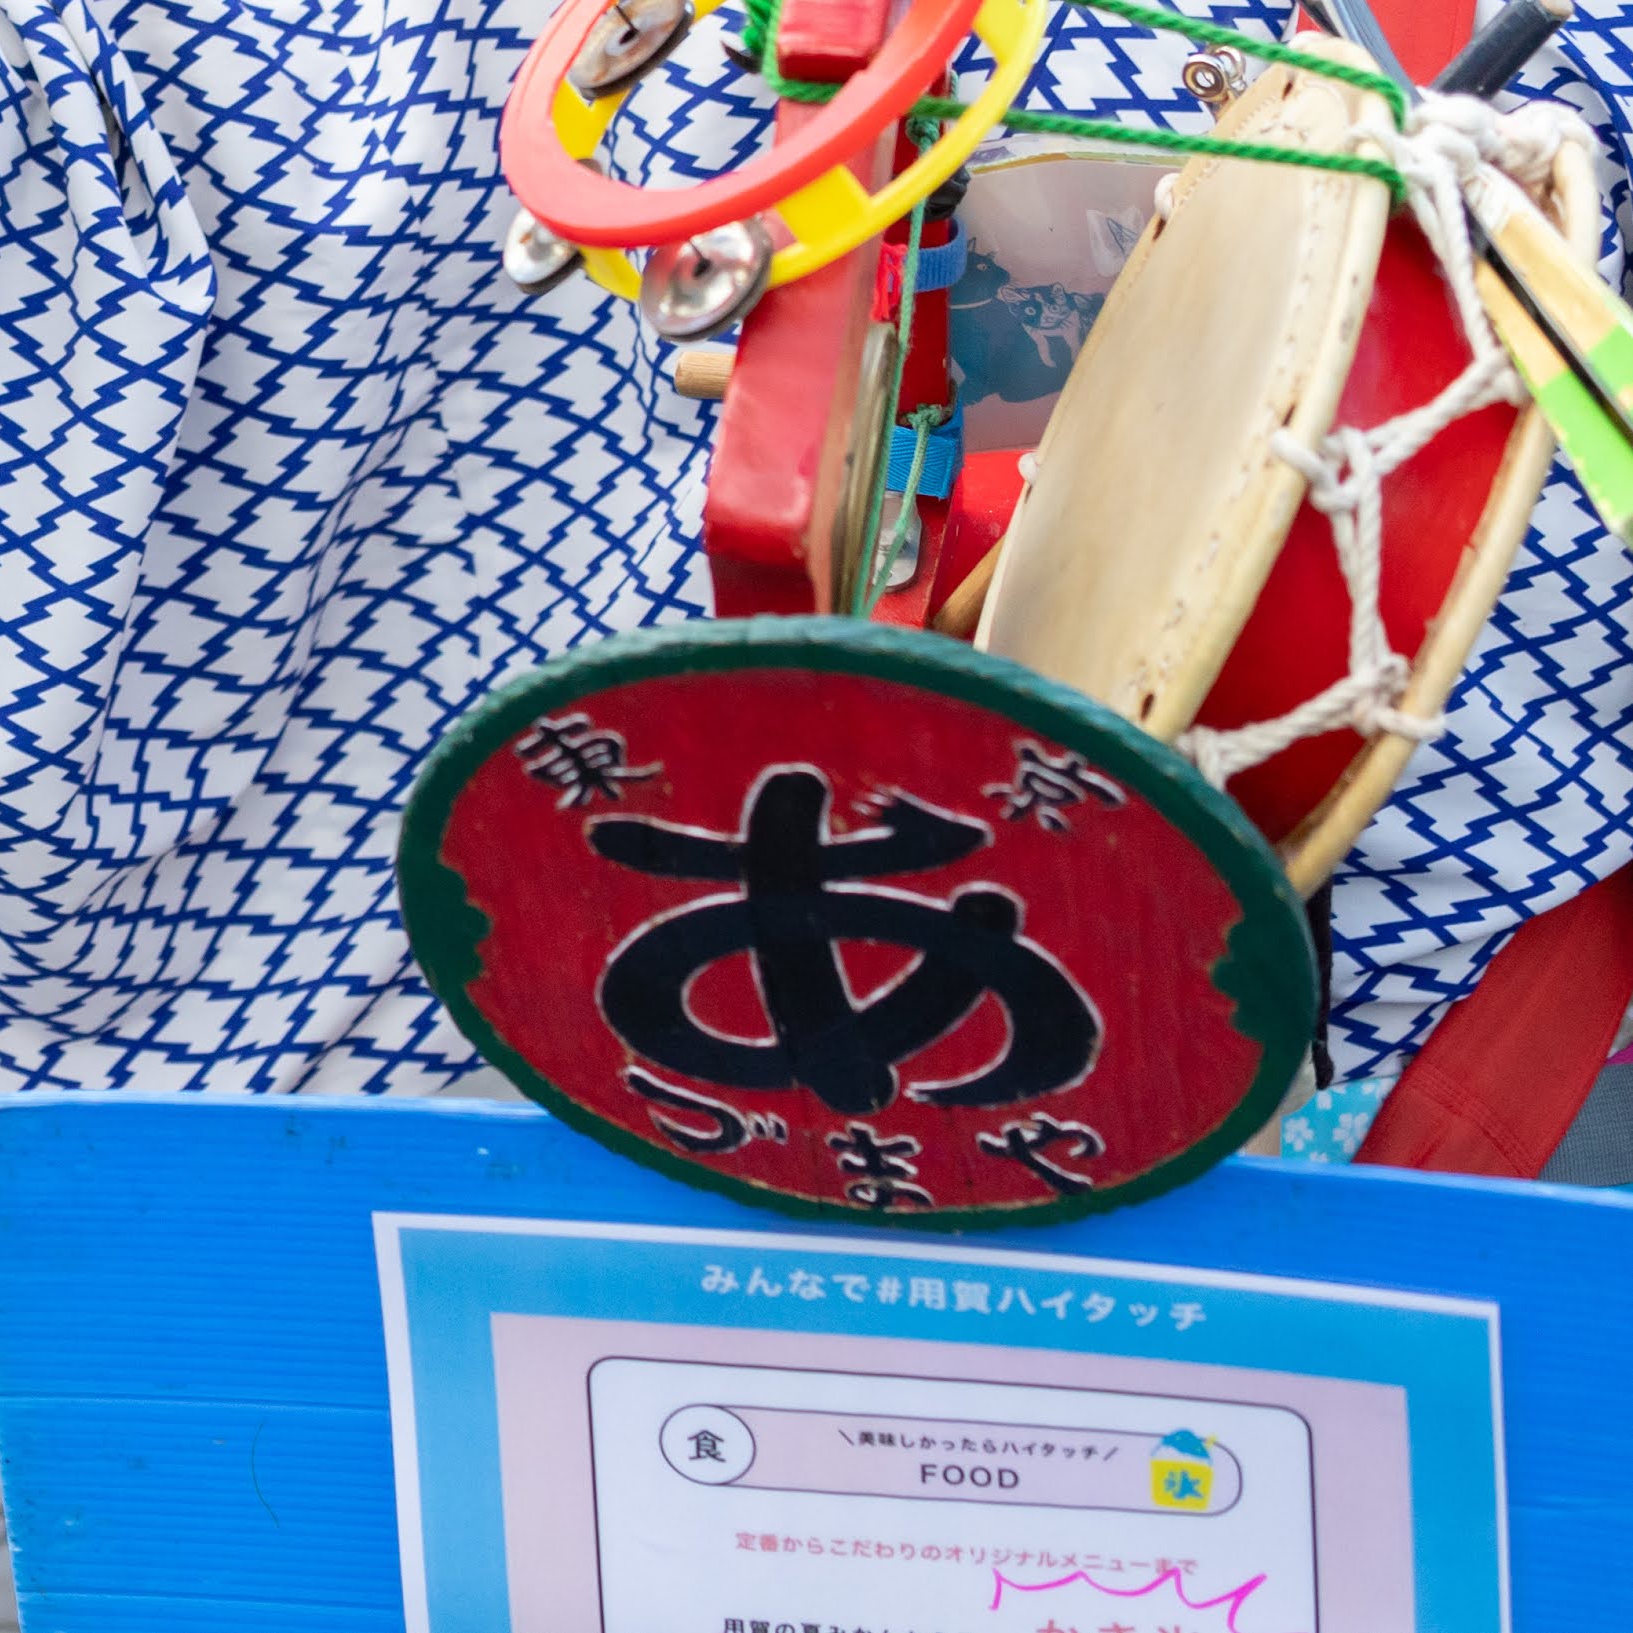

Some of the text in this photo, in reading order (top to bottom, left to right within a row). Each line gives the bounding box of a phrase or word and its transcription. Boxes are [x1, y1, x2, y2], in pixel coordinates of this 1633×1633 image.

[687, 1429, 726, 1464] 食
[919, 1462, 1020, 1489] FOOD
[1163, 1470, 1204, 1500] 氷
